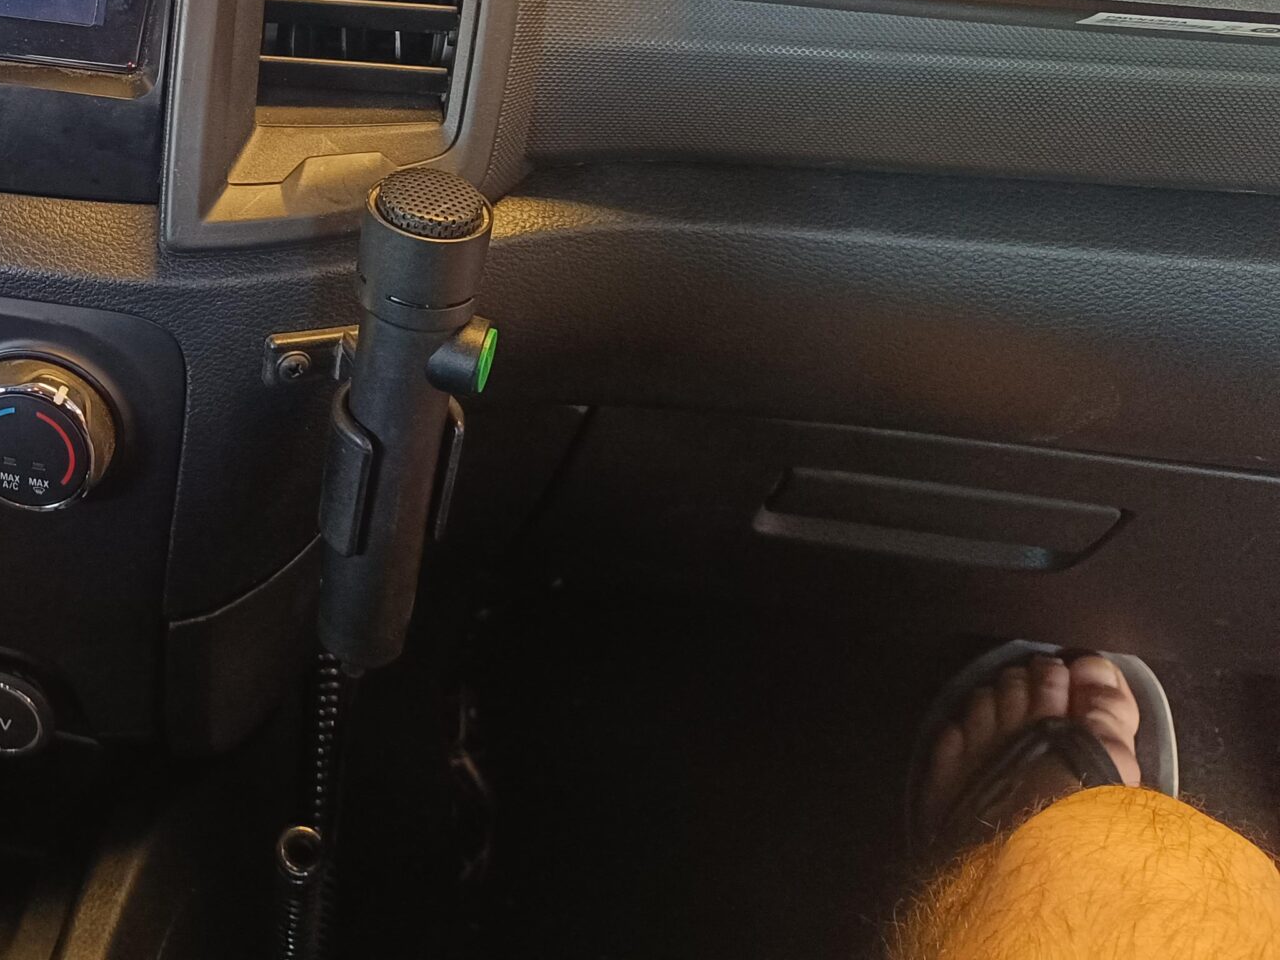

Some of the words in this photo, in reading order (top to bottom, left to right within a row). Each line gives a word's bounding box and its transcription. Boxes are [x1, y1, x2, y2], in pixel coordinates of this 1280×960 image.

[0, 472, 20, 483] MAX
[28, 477, 50, 489] MAX
[2, 480, 19, 491] A/C
